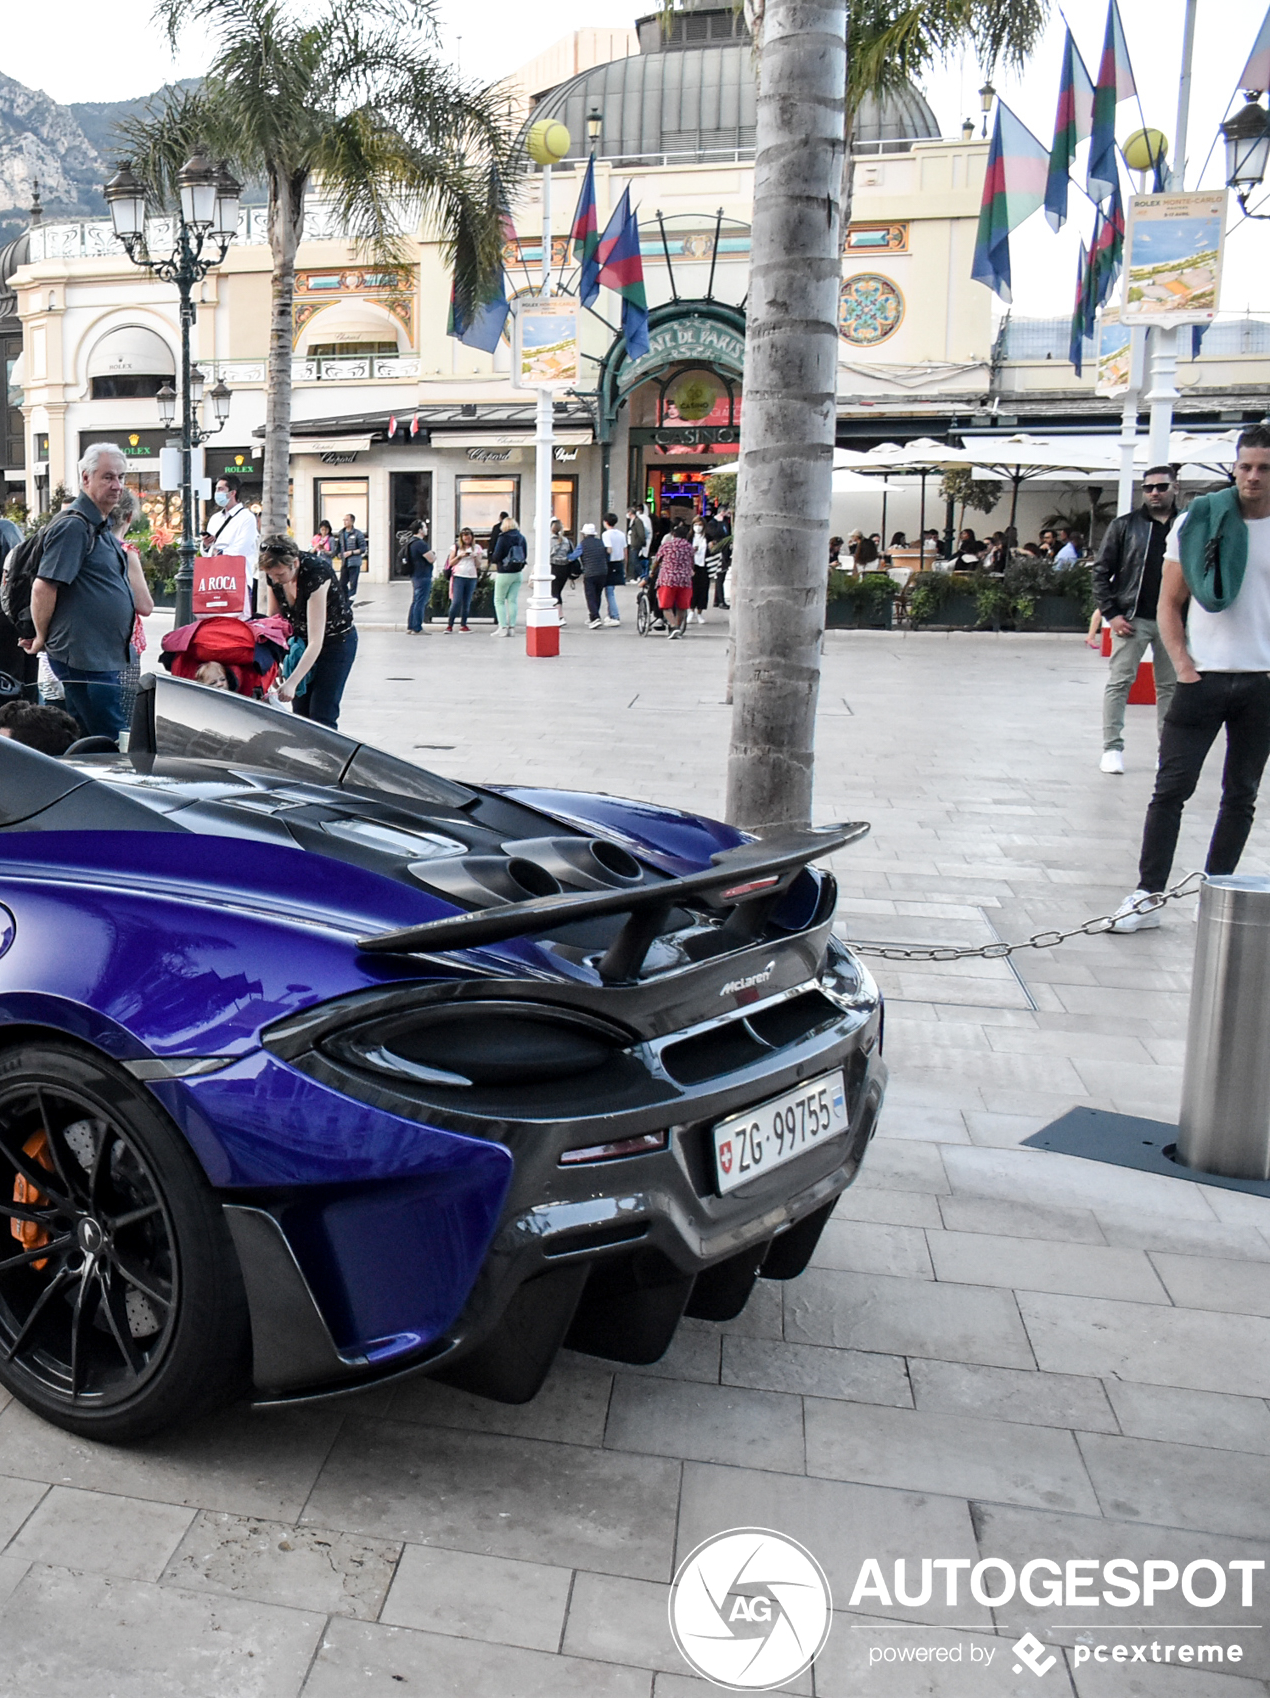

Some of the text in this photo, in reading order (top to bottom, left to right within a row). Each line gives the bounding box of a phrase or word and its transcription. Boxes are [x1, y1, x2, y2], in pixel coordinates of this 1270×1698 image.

[1134, 196, 1223, 208] ROLEX MONTE-CARLO
[677, 330, 696, 345] DE
[700, 330, 745, 358] PARIS
[655, 428, 735, 444] CASINO
[467, 448, 512, 463] Chopard
[198, 576, 237, 592] A ROCA
[719, 968, 772, 997] McLaren
[735, 1088, 831, 1173] ZG 99755
